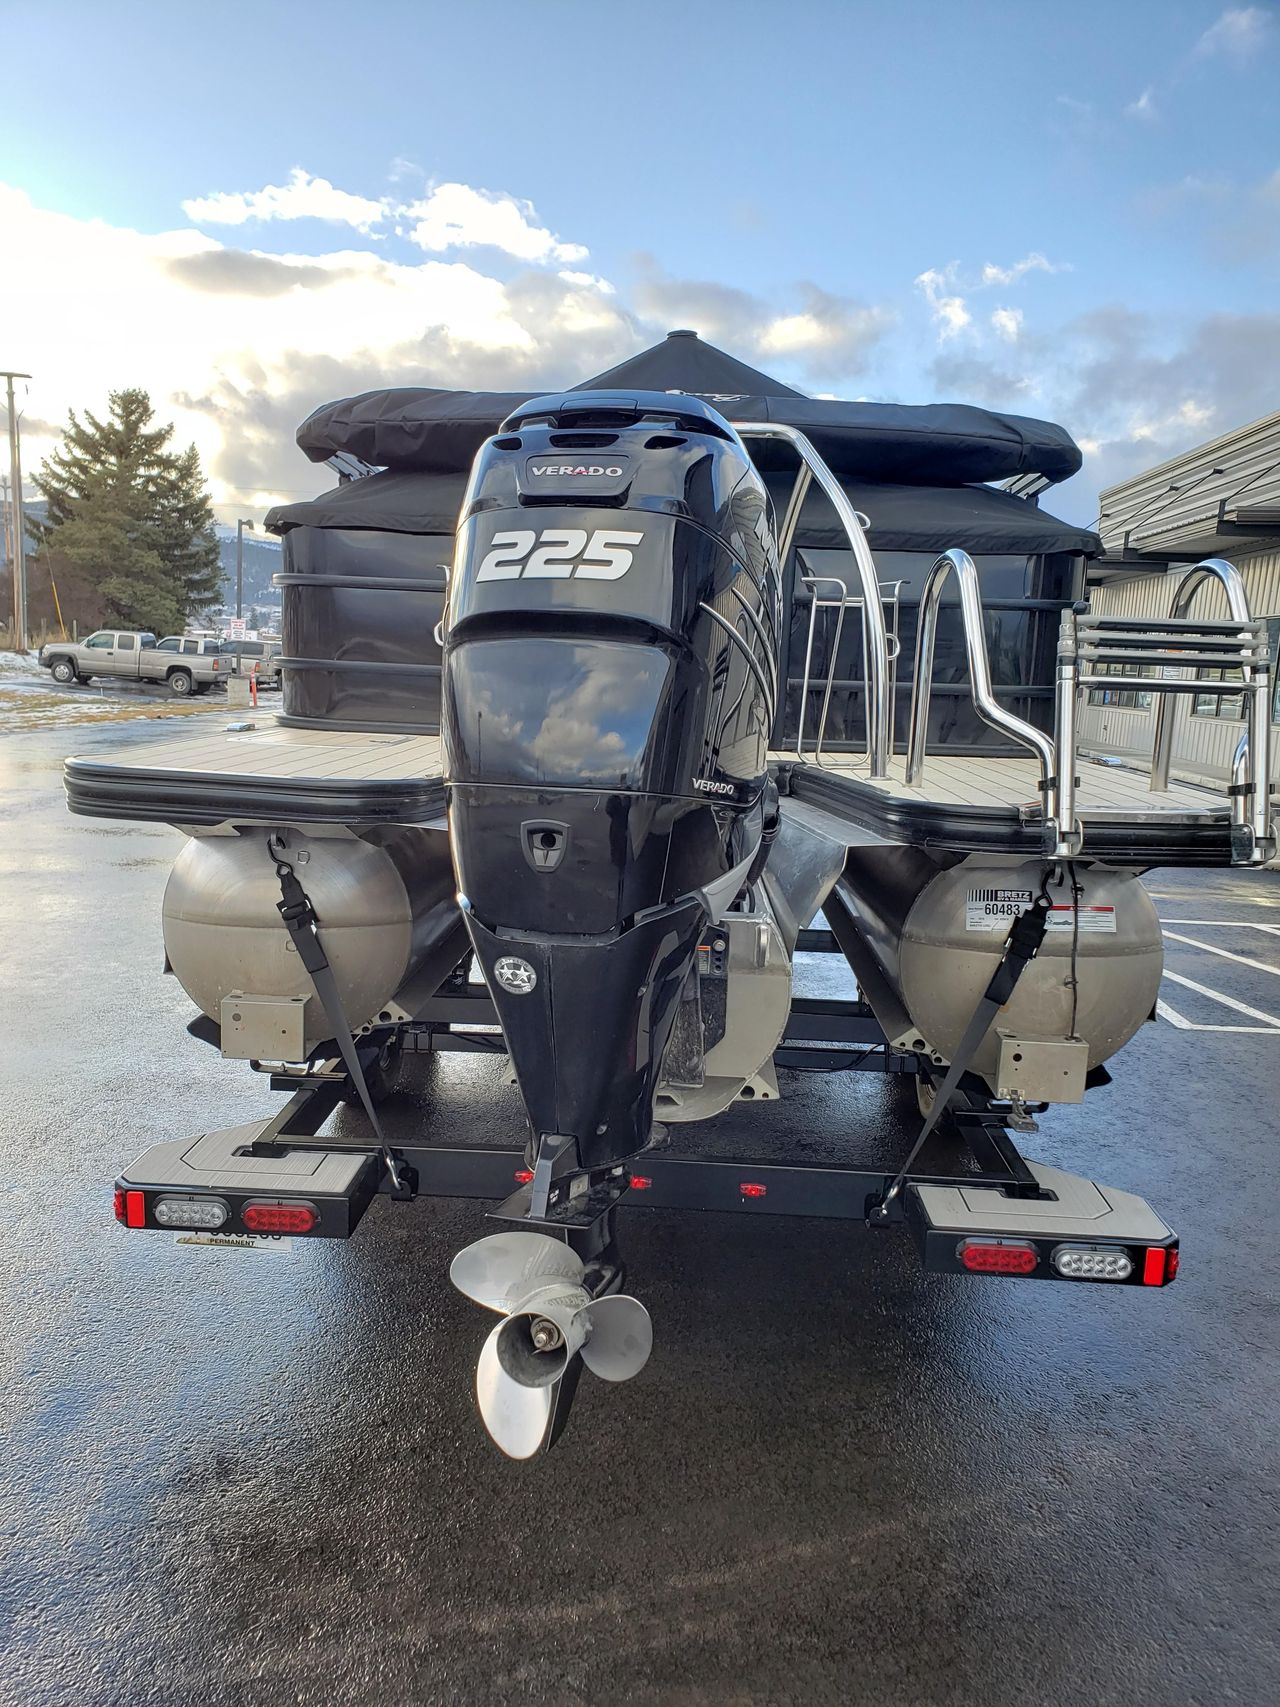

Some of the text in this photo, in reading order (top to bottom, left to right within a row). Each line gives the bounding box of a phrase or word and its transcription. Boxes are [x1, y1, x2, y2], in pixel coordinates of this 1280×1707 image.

[532, 466, 624, 477] VERADO
[476, 529, 645, 584] 225
[691, 777, 735, 795] VERADO
[997, 890, 1030, 899] BRETZ
[984, 903, 1021, 916] 60483
[209, 1238, 256, 1246] PERMANENT
